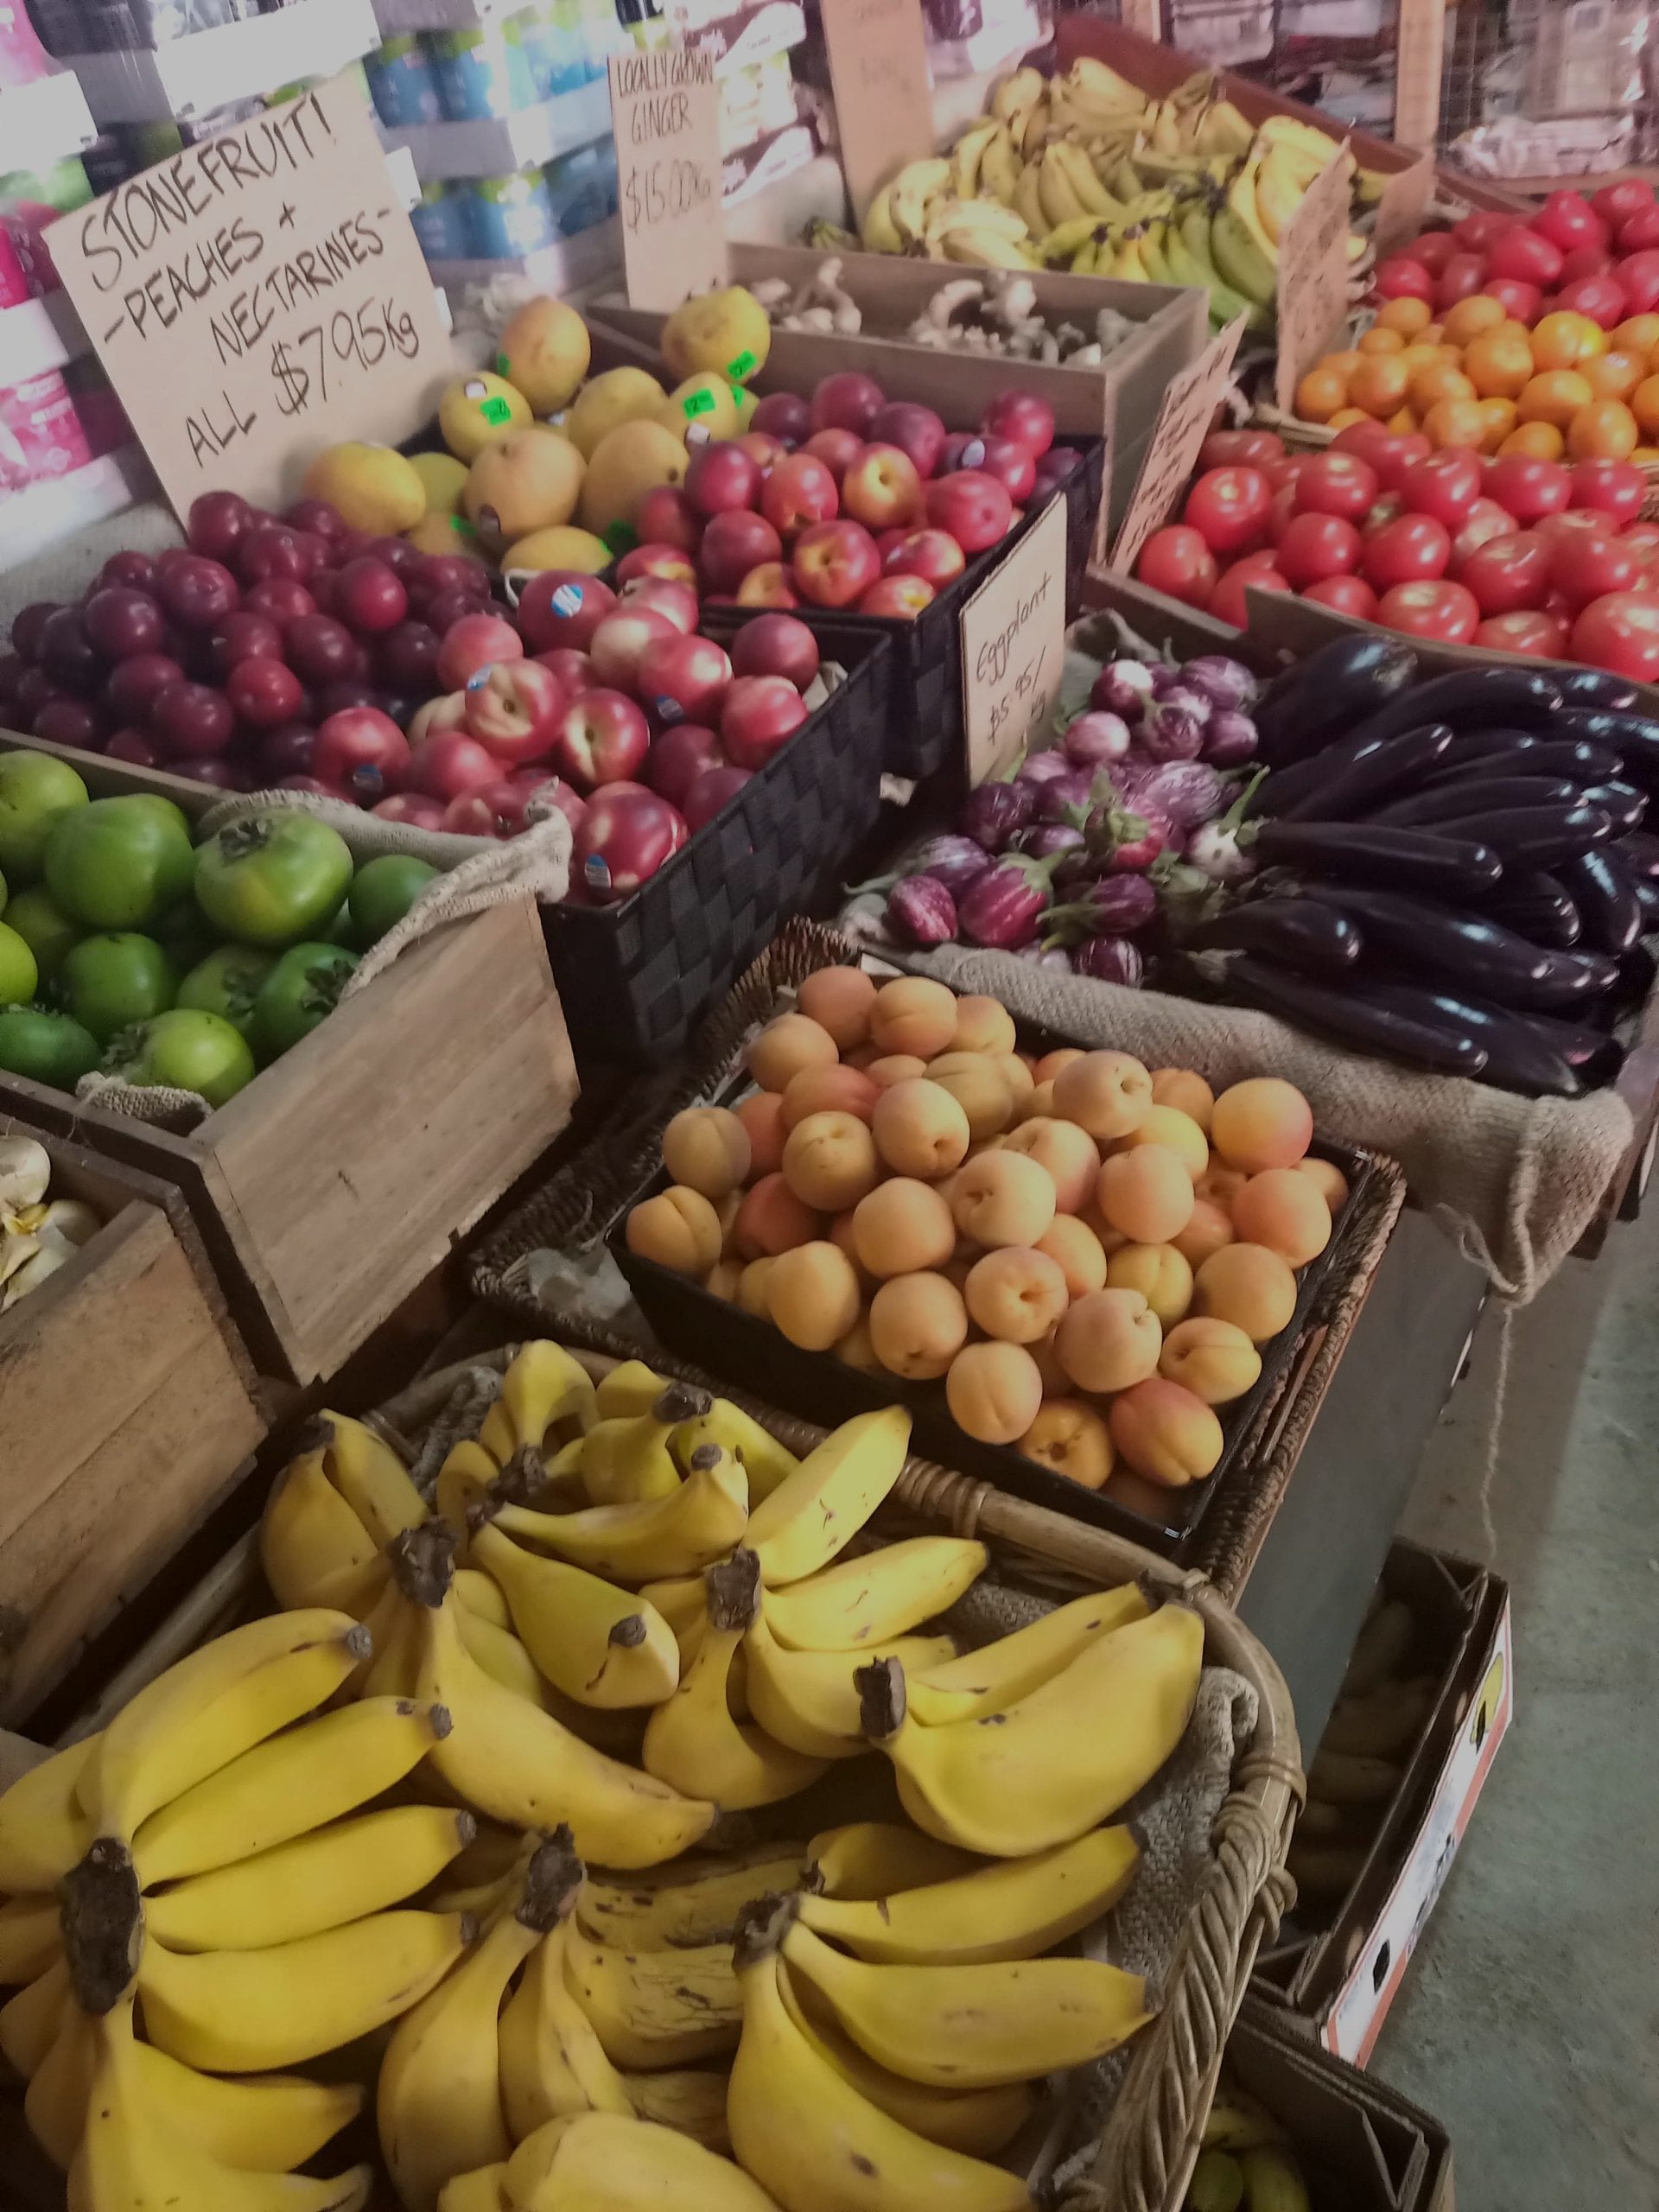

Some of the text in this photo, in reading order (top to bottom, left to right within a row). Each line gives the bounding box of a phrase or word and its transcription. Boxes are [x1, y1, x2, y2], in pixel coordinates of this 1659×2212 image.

[632, 90, 693, 145] GINGER
[278, 200, 296, 230] +
[185, 391, 257, 468] ALL
[976, 571, 1052, 687] Eggplant
